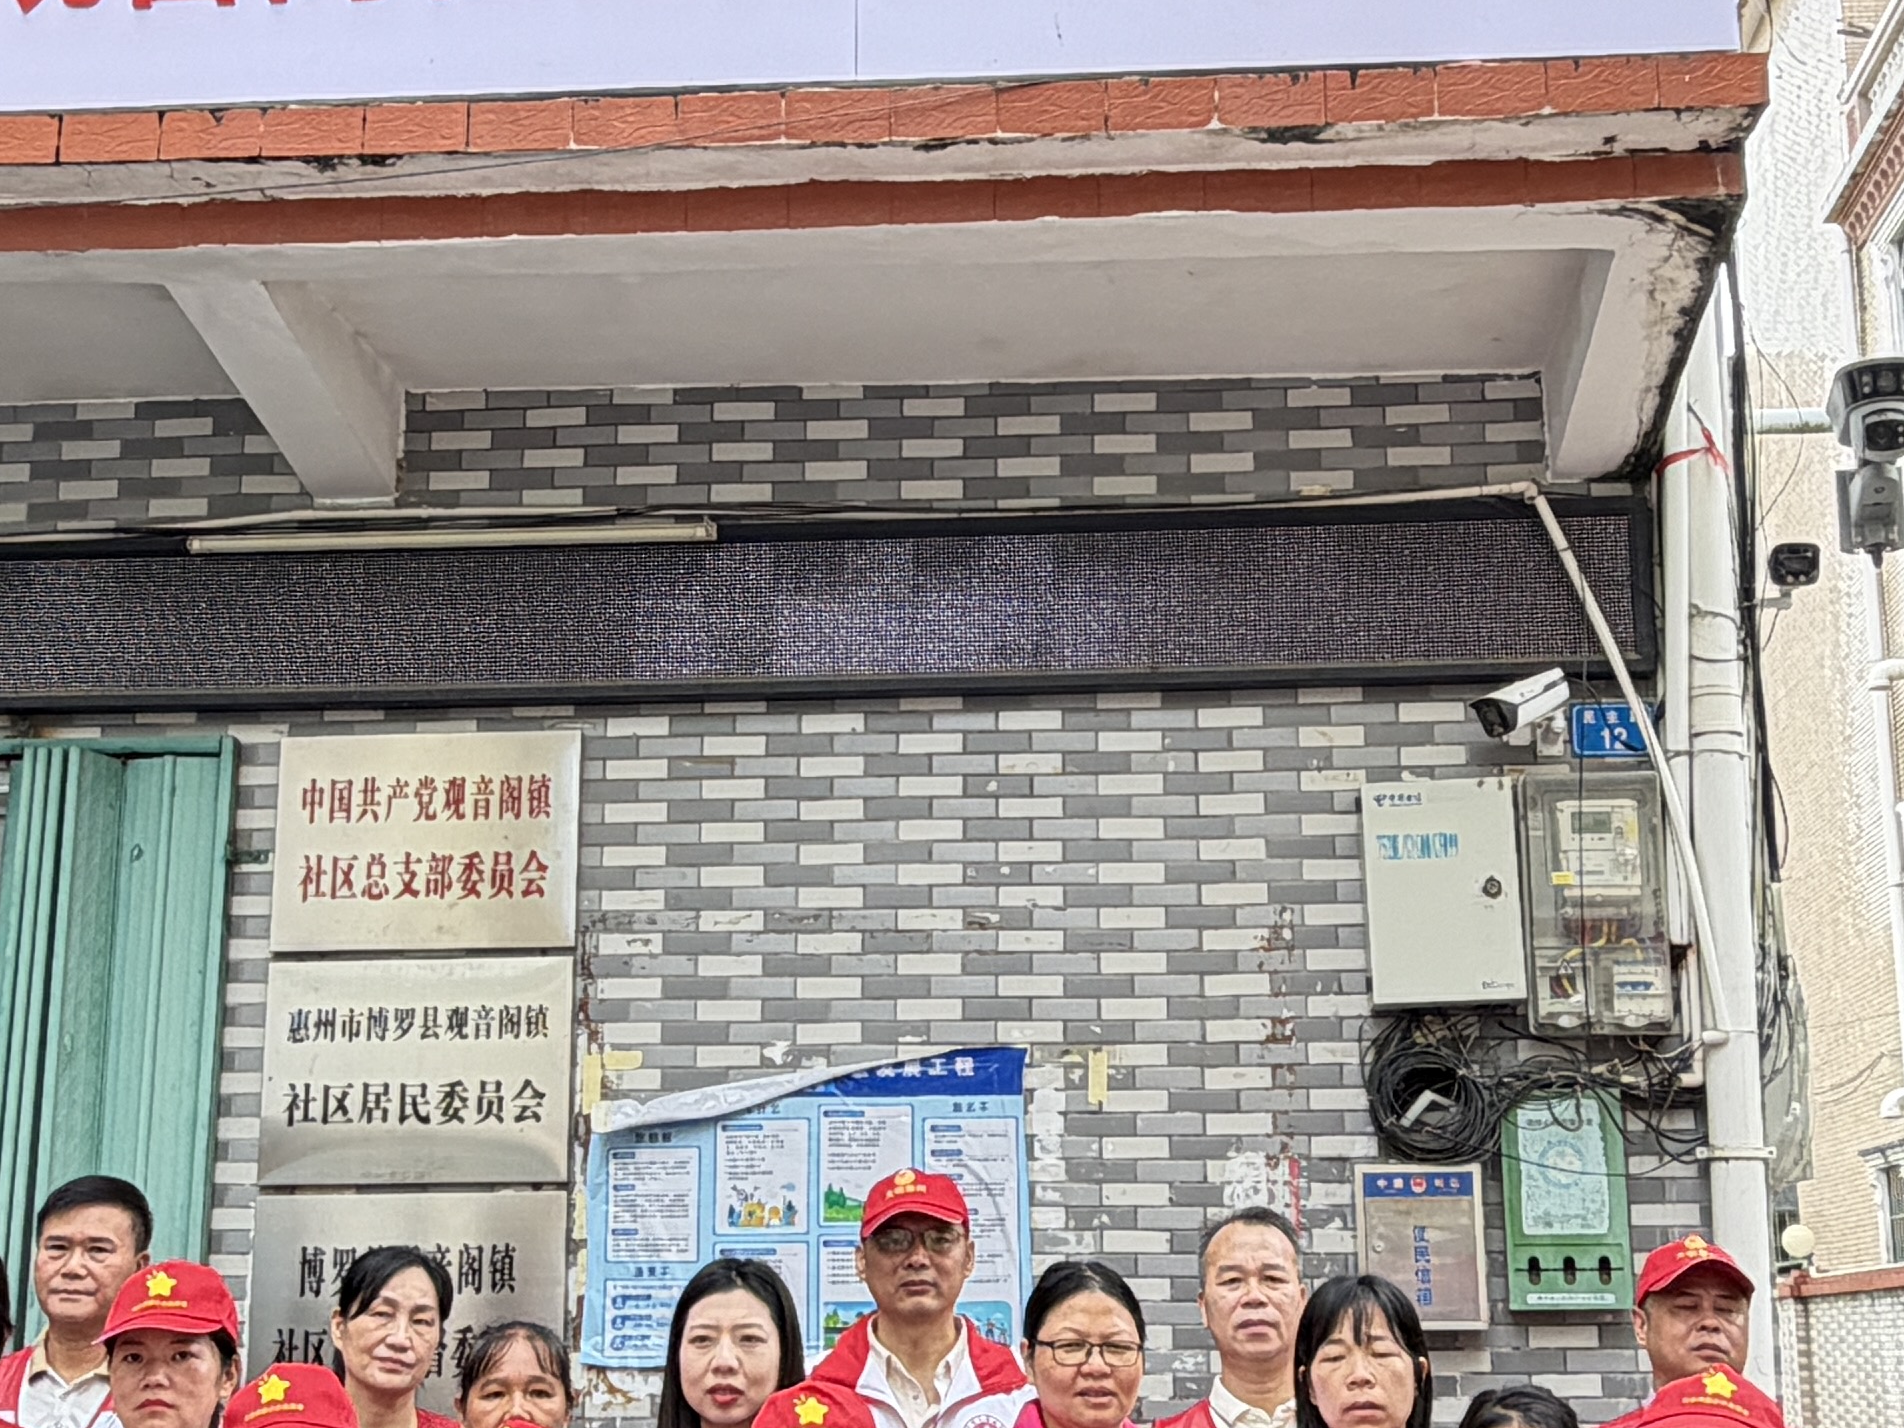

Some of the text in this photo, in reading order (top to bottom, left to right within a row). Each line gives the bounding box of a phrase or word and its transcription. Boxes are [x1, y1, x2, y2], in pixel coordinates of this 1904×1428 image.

[1600, 727, 1628, 750] 12
[301, 773, 552, 825] 中国共产党观音阁镇
[298, 849, 549, 903] 社区总支部委员会
[286, 1004, 550, 1044] 惠州市博罗县观音阁镇
[282, 1078, 546, 1127] 社区居民委员会
